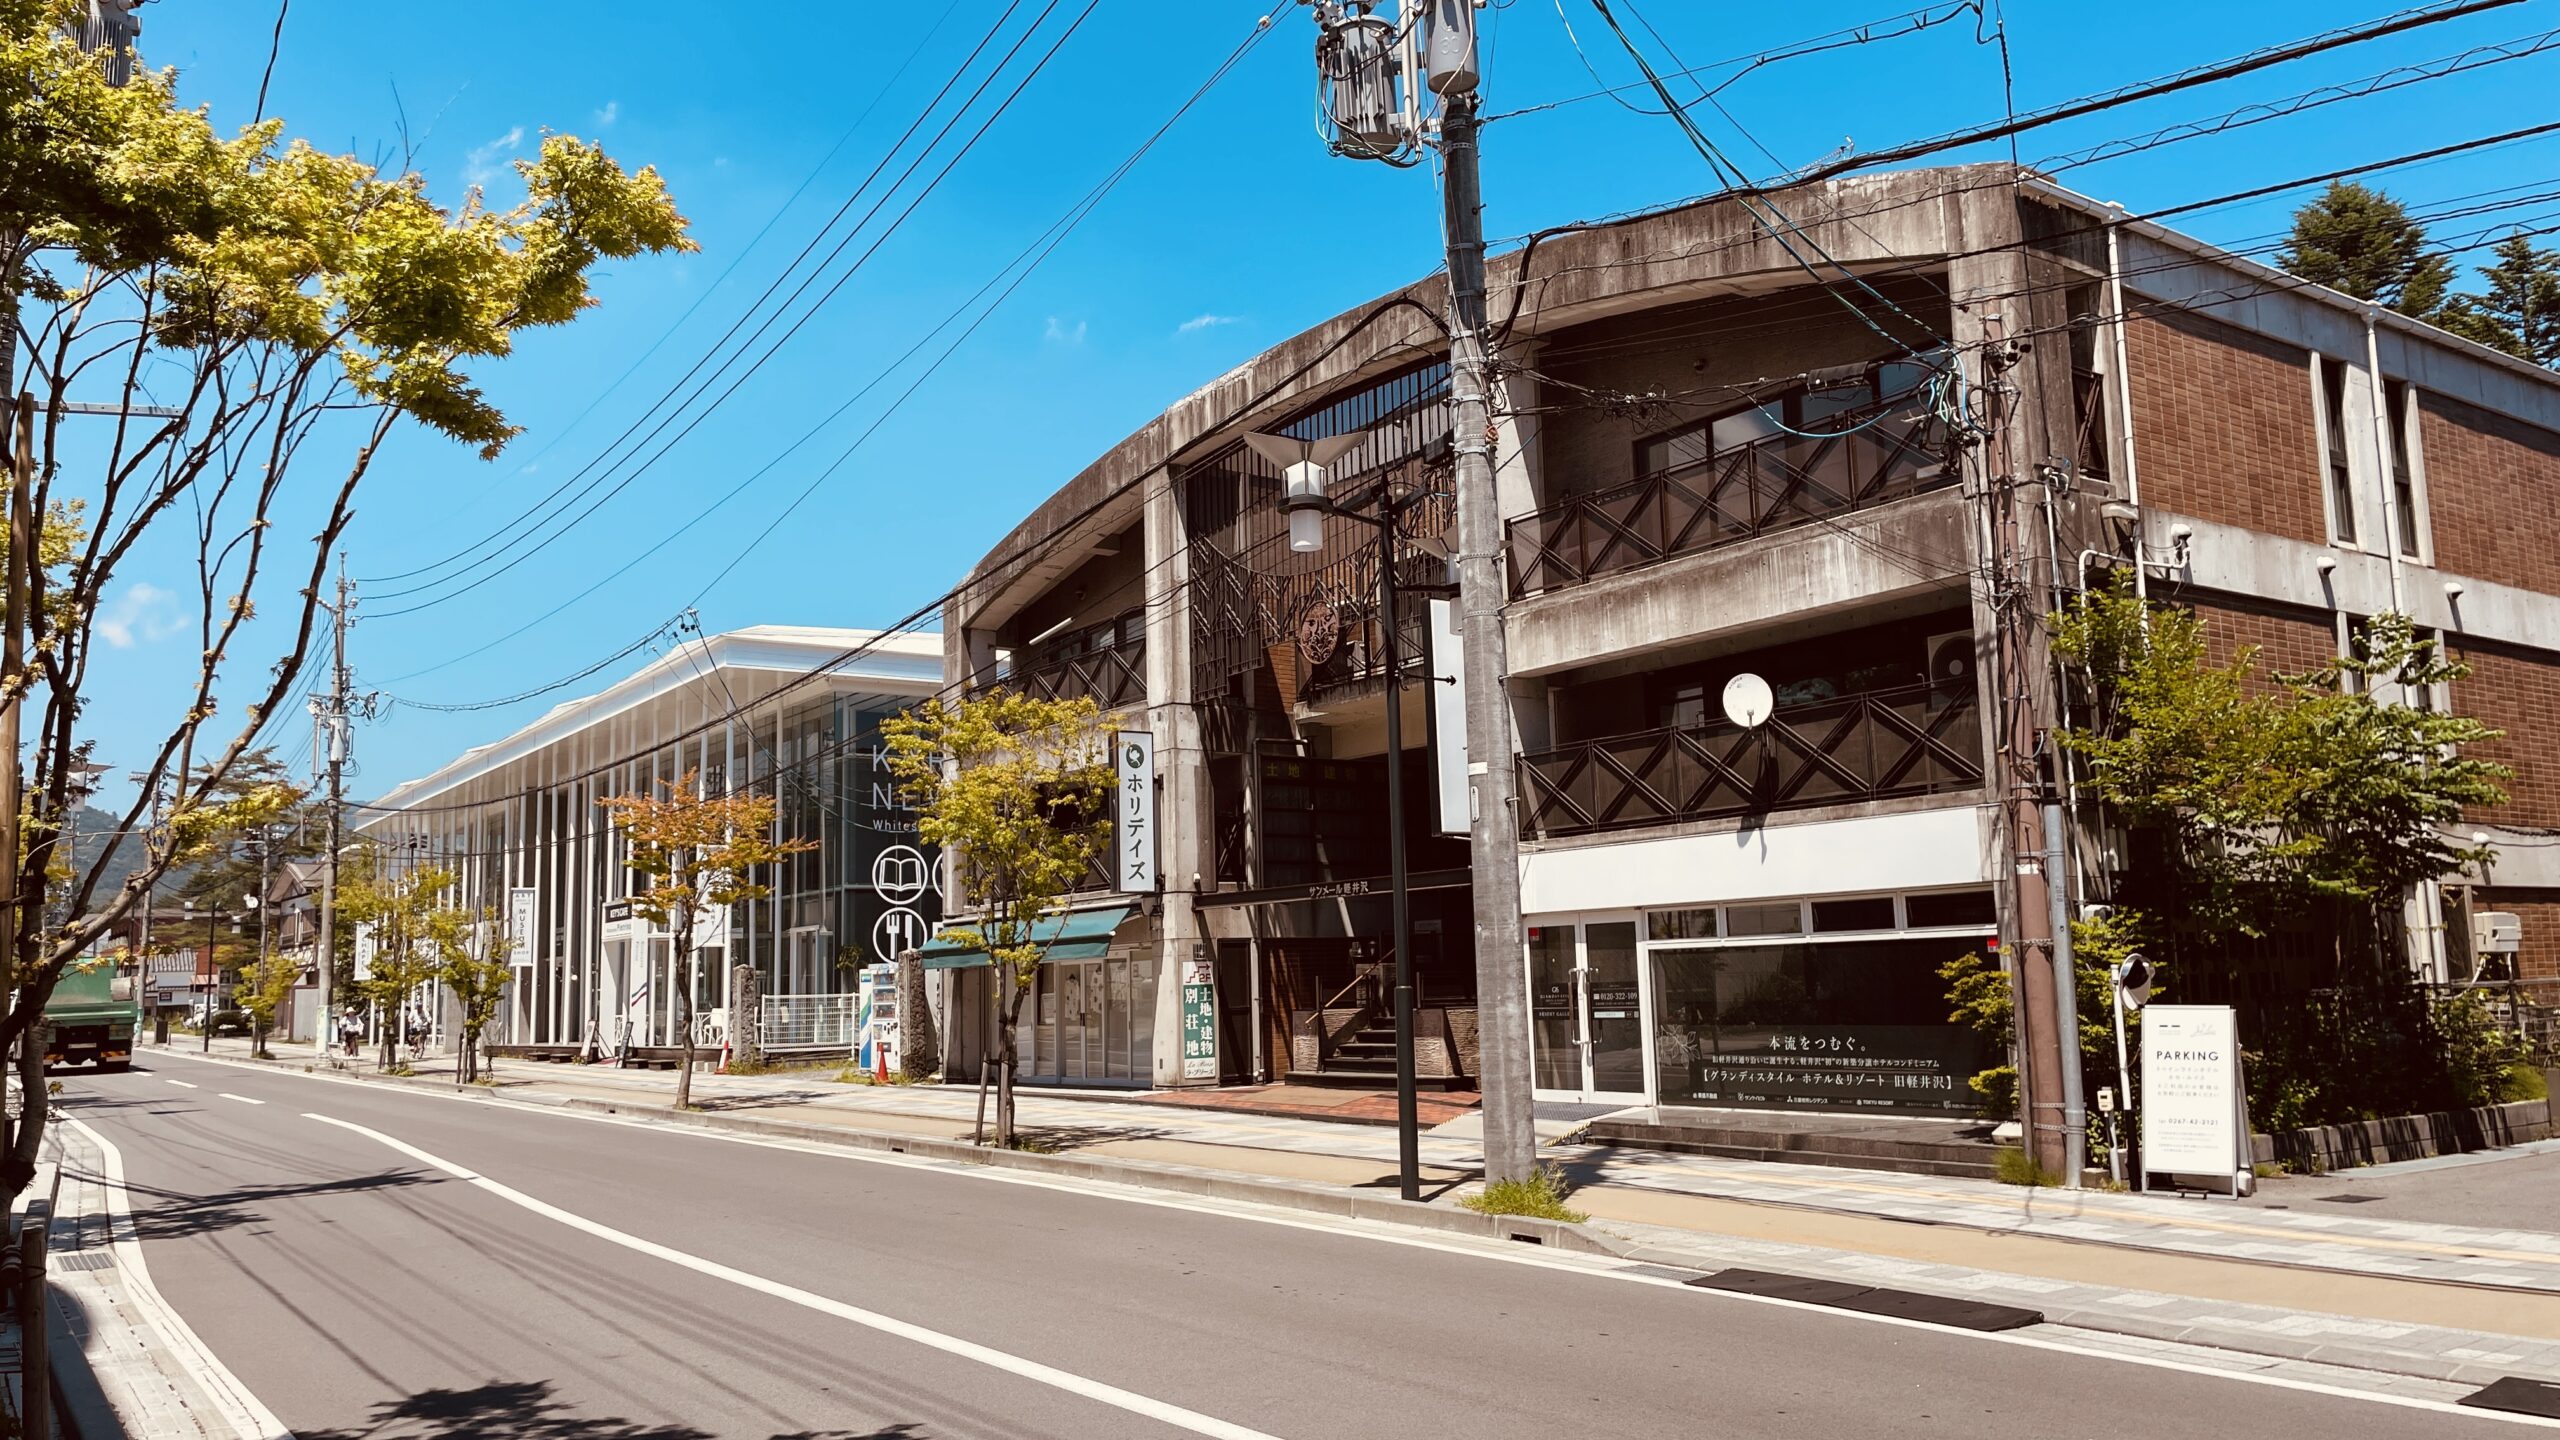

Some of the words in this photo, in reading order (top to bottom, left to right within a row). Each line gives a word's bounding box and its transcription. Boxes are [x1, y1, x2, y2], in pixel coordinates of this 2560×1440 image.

[1127, 773, 1146, 881] ホリデイズ
[1309, 881, 1369, 897] サンメール軽井沢
[1199, 973, 1211, 983] 2F
[1185, 988, 1199, 1056] 別荘地
[1199, 987, 1213, 1056] 土地・建物
[1769, 1035, 1867, 1052] 本流をつむぐ。
[2156, 1050, 2219, 1061] PARKING
